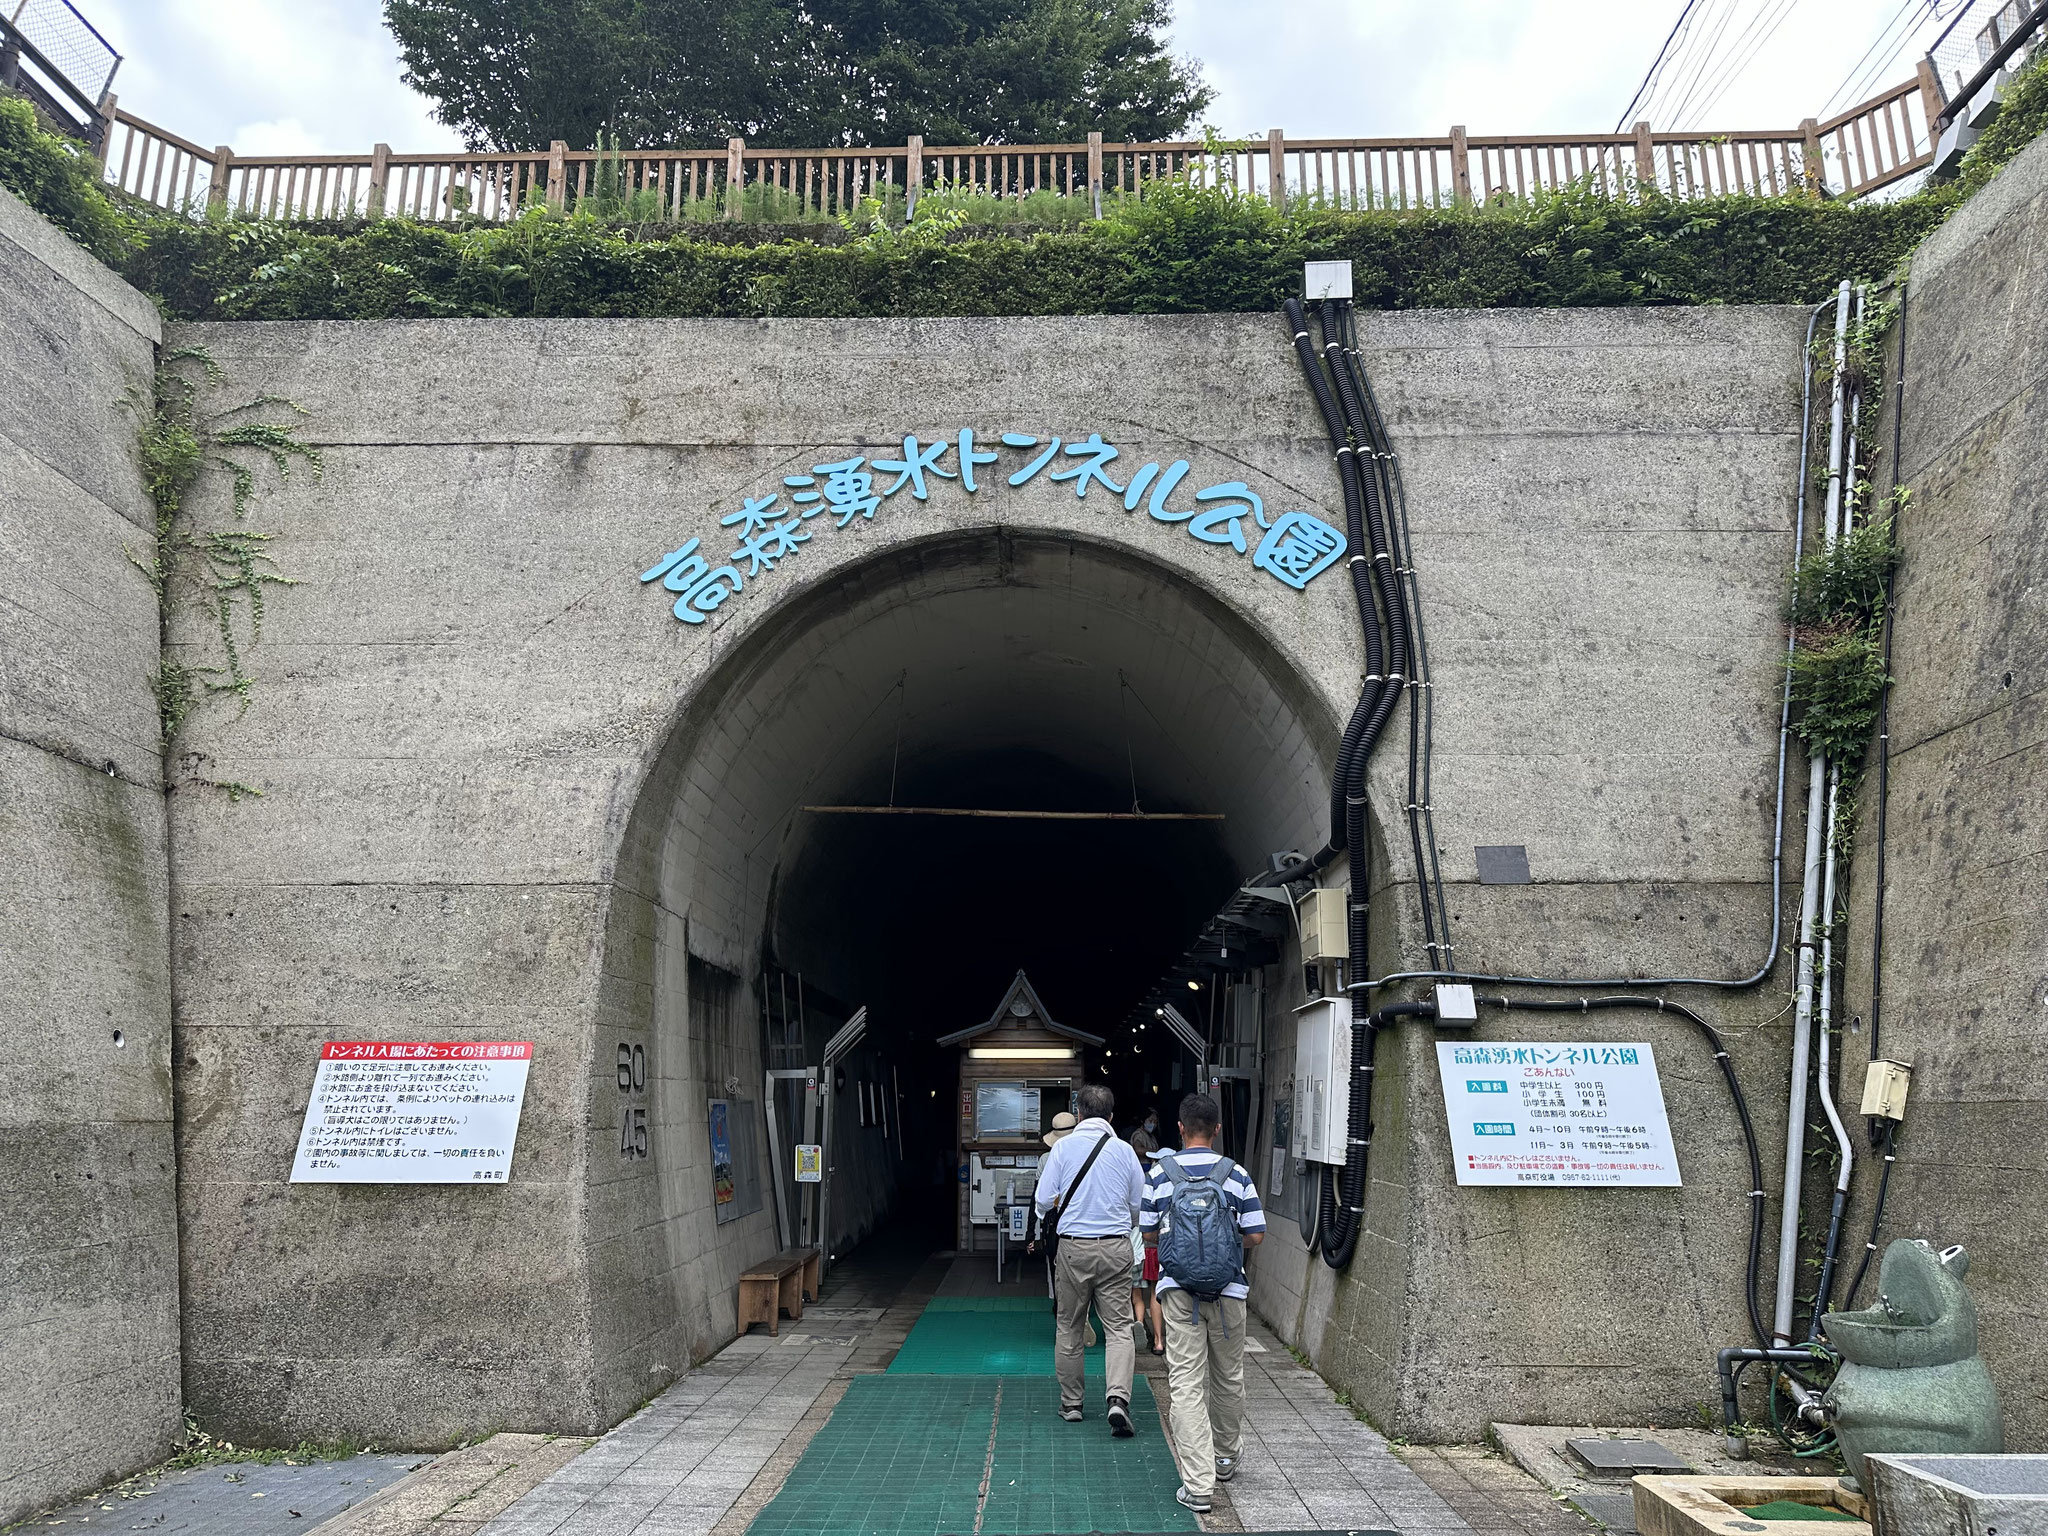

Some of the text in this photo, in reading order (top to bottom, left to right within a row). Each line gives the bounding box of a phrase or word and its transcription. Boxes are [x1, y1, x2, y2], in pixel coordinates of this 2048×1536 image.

[640, 427, 1349, 624] 高森湧水トンネル公園
[329, 1045, 525, 1058] トンネル入場にあたっての注意事項
[1454, 1047, 1639, 1065] 高森湧水トンネル公園
[1523, 1068, 1575, 1077] ごあんない
[1520, 1081, 1562, 1090] 中学生以上
[620, 1108, 648, 1160] 45
[1475, 1124, 1513, 1134] 入園時間
[310, 1159, 341, 1169] ません。
[1014, 1209, 1023, 1229] 出口
